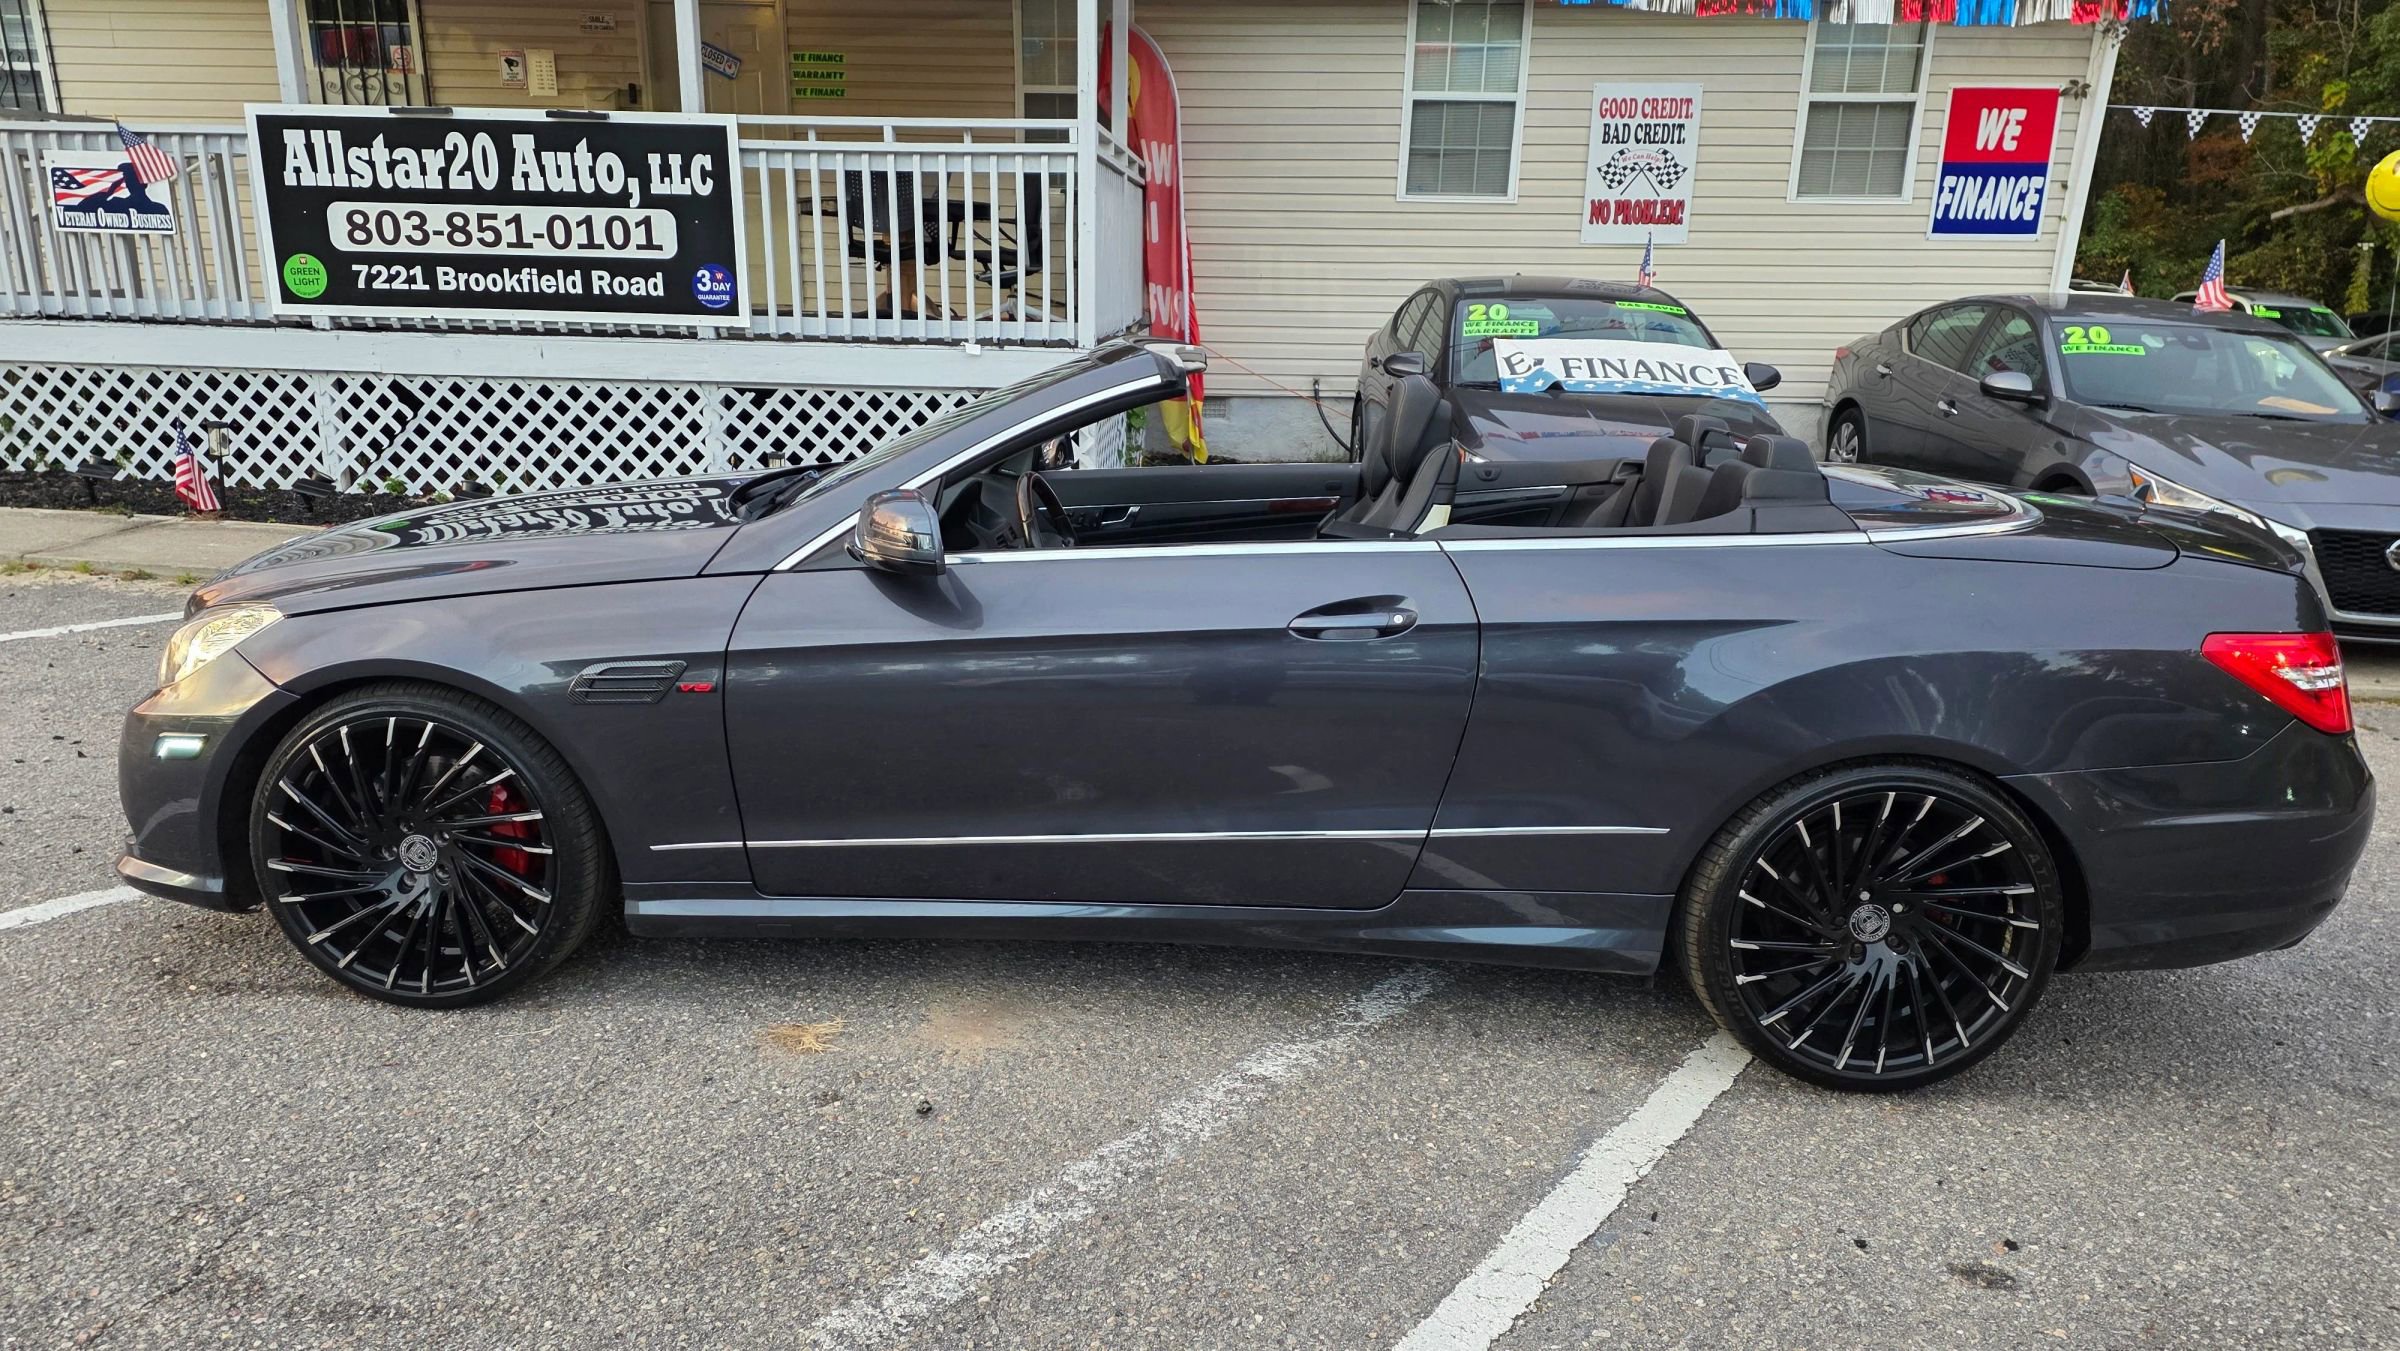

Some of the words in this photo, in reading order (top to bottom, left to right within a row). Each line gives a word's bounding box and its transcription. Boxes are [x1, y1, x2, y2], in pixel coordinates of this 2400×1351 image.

[793, 53, 806, 62] WE
[808, 53, 845, 63] FINANCE
[793, 70, 845, 79] WARRANTY
[795, 88, 808, 96] WE
[810, 88, 846, 97] FINANCE
[1599, 97, 1638, 119] GOOD
[1641, 97, 1694, 119] CREDIT.
[1602, 123, 1631, 144] BAD
[1634, 123, 1686, 144] CREDIT.
[1976, 107, 2028, 152] WE
[282, 128, 499, 191] Allstar20
[511, 133, 641, 208] Auto,
[647, 153, 714, 196] LLC
[1632, 153, 1645, 161] Can
[1936, 175, 2045, 221] FINANCE
[56, 205, 98, 228] VETERAN
[97, 207, 130, 229] OWNED
[129, 208, 172, 229] BUSINESS
[1588, 198, 1612, 225] NO
[1613, 198, 1686, 225] PROBLEM!
[345, 209, 664, 252] 803-851-0101
[290, 267, 321, 276] GREEN
[293, 278, 321, 286] LIGHT
[351, 264, 431, 292] 7221
[436, 266, 584, 295] Brookfield
[591, 271, 665, 297] Road
[696, 269, 712, 292] 3
[712, 282, 732, 291] DAY
[1467, 303, 1510, 321] 20
[2063, 326, 2112, 344] 20
[2087, 345, 2141, 353] FINANCE
[1560, 356, 1745, 388] FINANCE
[2028, 853, 2056, 929] ATLAS
